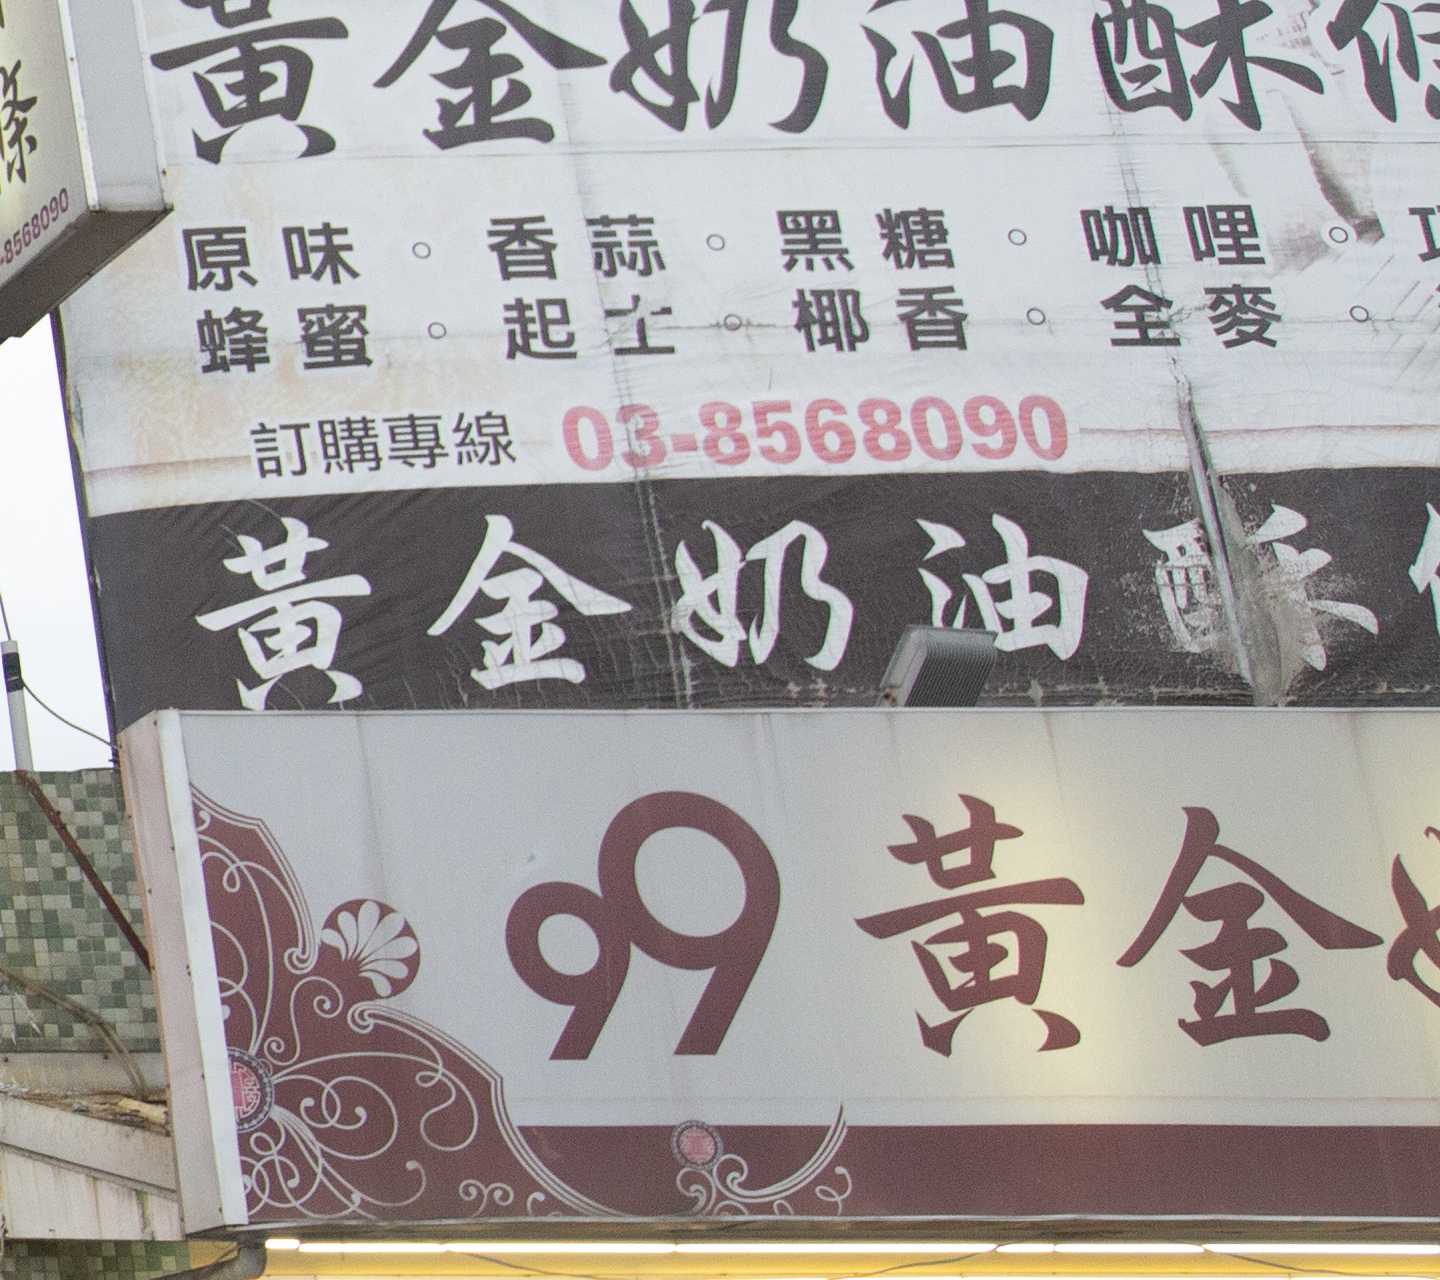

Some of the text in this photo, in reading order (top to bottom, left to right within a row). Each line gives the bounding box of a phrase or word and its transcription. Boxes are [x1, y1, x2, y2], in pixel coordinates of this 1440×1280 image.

[182, 204, 1268, 292] 原味 香蒜 黑糖 咖哩
[197, 283, 1282, 373] 蜂蜜 起士 椰香 全麥
[250, 395, 1069, 478] 訂購專線 03-8568090
[195, 503, 1440, 712] 黃金奶油酥
[506, 791, 1440, 1060] 99 黃金
